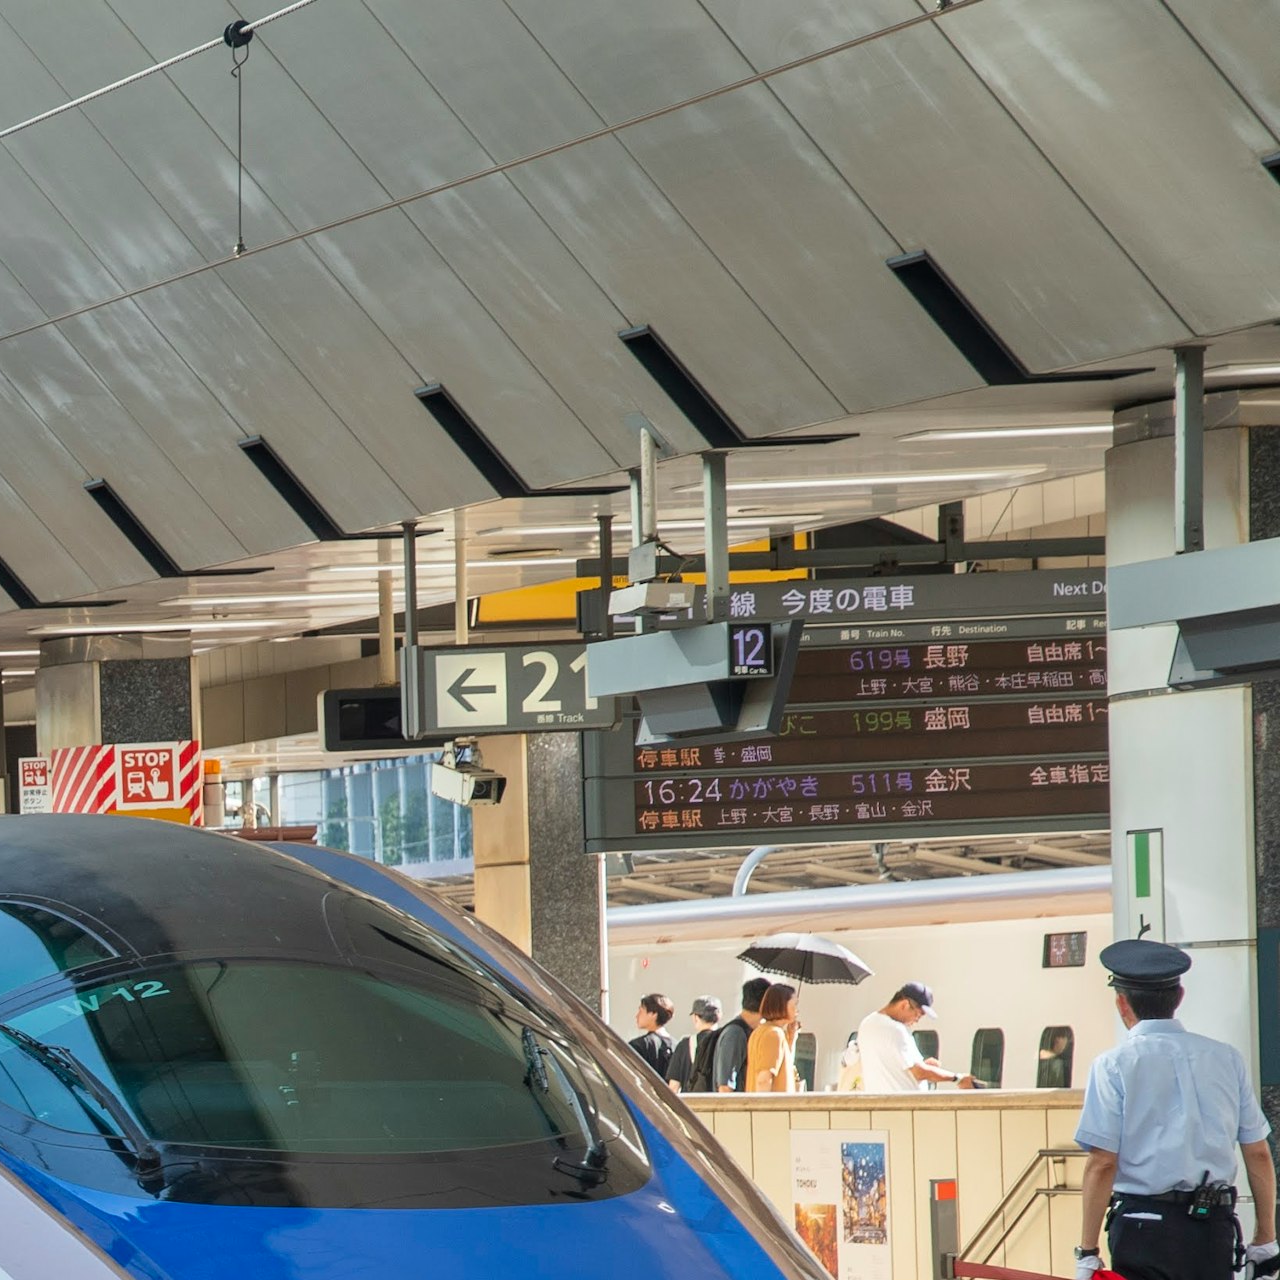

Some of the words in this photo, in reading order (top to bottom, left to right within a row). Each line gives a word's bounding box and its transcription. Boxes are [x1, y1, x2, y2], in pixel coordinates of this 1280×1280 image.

[781, 584, 915, 615] 今度の電車
[1053, 582, 1089, 597] Next
[867, 629, 888, 638] Train
[890, 628, 905, 638] No.
[931, 626, 952, 637] 行先
[958, 624, 1008, 635] Destination
[1066, 618, 1087, 631] 記事
[732, 629, 765, 666] 12
[850, 648, 911, 670] 619号
[923, 644, 969, 669] 長野
[857, 668, 1108, 696] 上野・大宮・熊谷・本庄早稲田・高
[557, 713, 584, 723] Track
[853, 710, 912, 732] 199号
[924, 706, 971, 731] 盛岡
[23, 761, 46, 771] STOP
[124, 751, 170, 768] STOP
[637, 747, 702, 769] 停車駅
[644, 778, 723, 805] 16:24
[729, 774, 819, 800] かがやき
[851, 771, 913, 794] 511号
[925, 768, 972, 793] 金沢
[638, 808, 704, 830] 停車駅
[58, 994, 100, 1016] W
[111, 980, 171, 1002] 12
